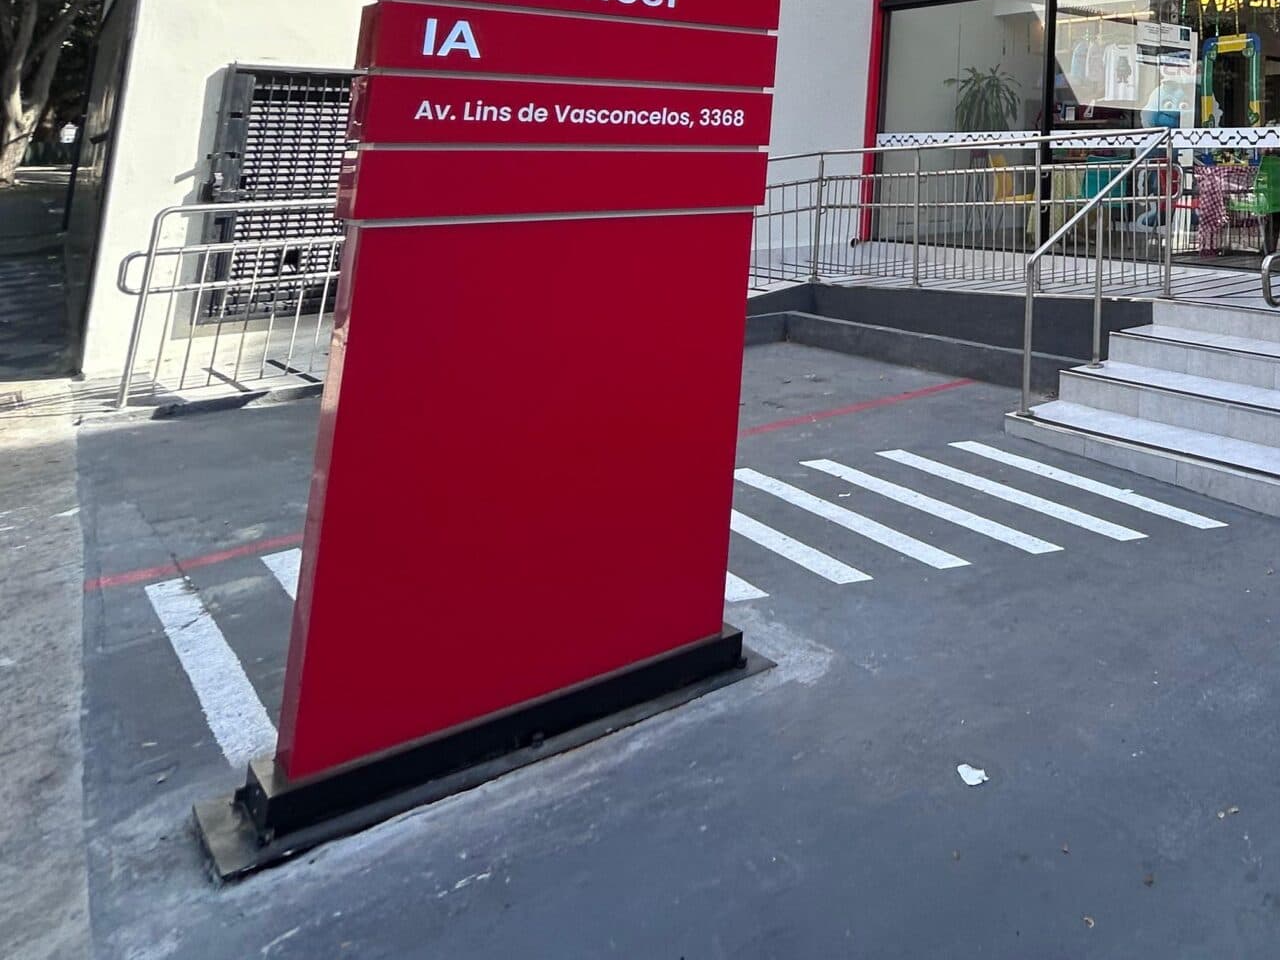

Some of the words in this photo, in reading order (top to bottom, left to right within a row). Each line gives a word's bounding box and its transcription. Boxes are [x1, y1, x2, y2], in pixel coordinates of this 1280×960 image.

[422, 17, 481, 59] IA
[414, 99, 457, 121] Av.
[463, 100, 513, 122] Lins
[517, 102, 549, 123] de
[554, 104, 695, 129] Vasconcelos,
[699, 107, 745, 127] 3368
